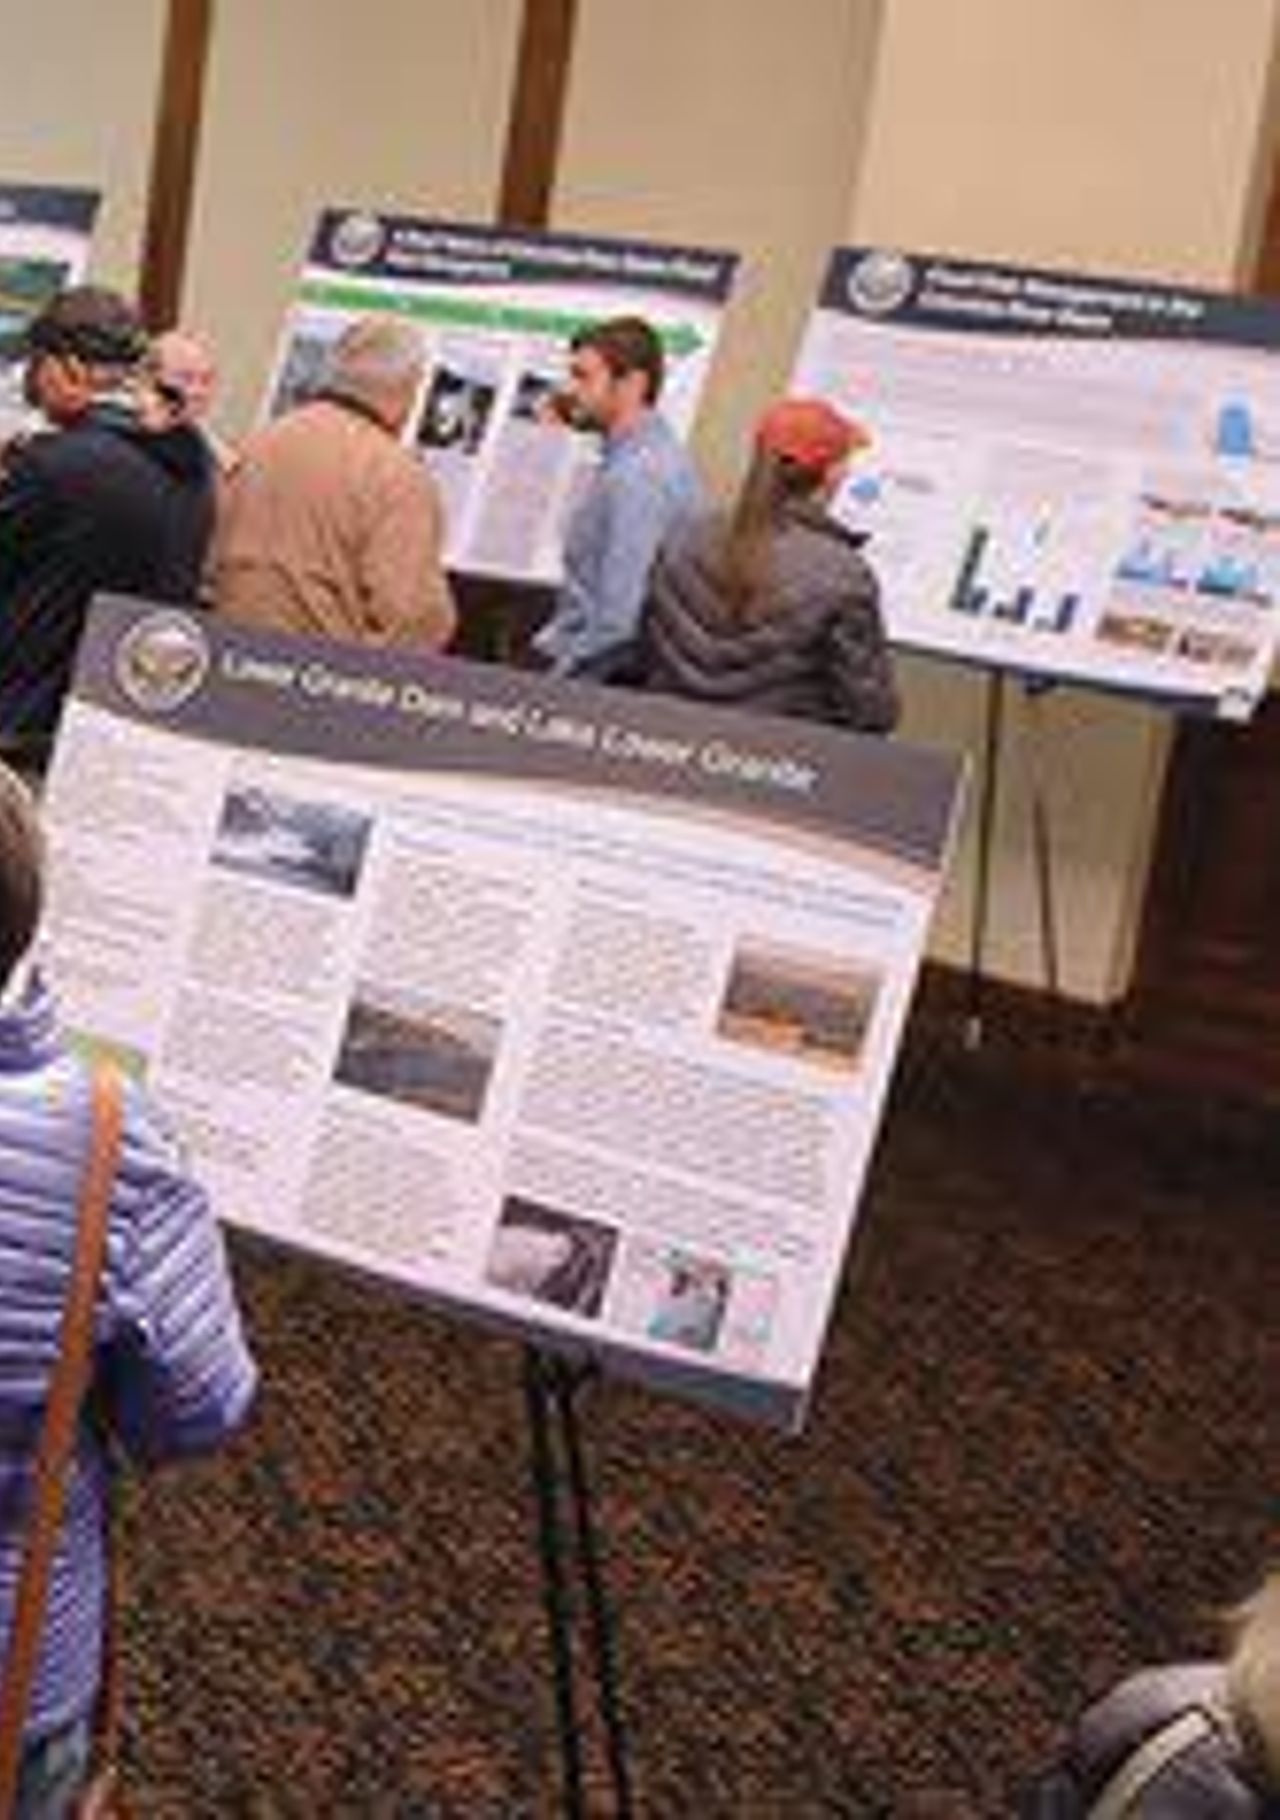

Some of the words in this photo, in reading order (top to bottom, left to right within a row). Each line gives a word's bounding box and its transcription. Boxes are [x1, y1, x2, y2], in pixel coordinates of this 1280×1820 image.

[223, 651, 292, 684] Lower
[301, 662, 395, 705] Granite
[401, 685, 464, 719] Dam
[470, 700, 525, 735] and
[528, 705, 596, 748] Lake
[602, 724, 693, 765] Lower
[701, 738, 819, 789] Granite
